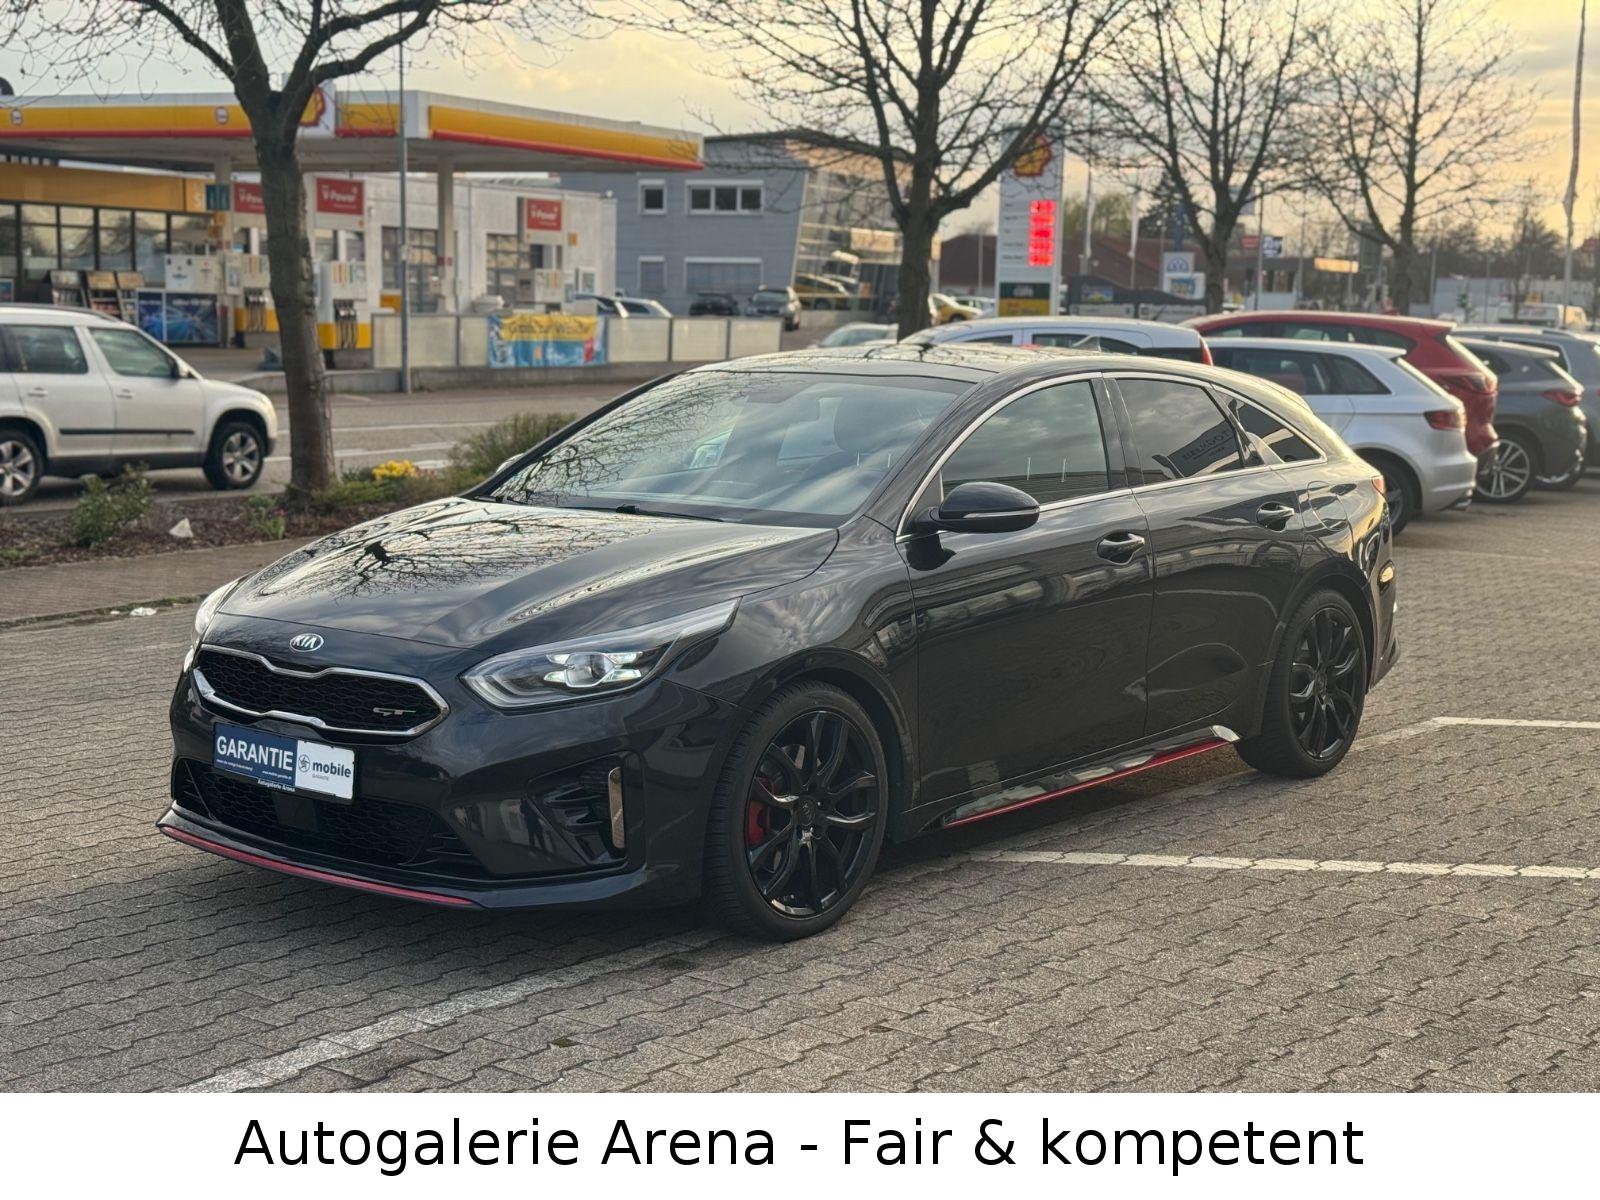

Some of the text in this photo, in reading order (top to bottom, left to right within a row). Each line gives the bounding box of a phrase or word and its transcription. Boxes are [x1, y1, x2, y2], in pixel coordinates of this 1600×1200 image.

[292, 634, 317, 649] KIA
[216, 736, 294, 771] GARANTIE
[312, 760, 352, 778] mobile
[282, 784, 296, 792] Arena
